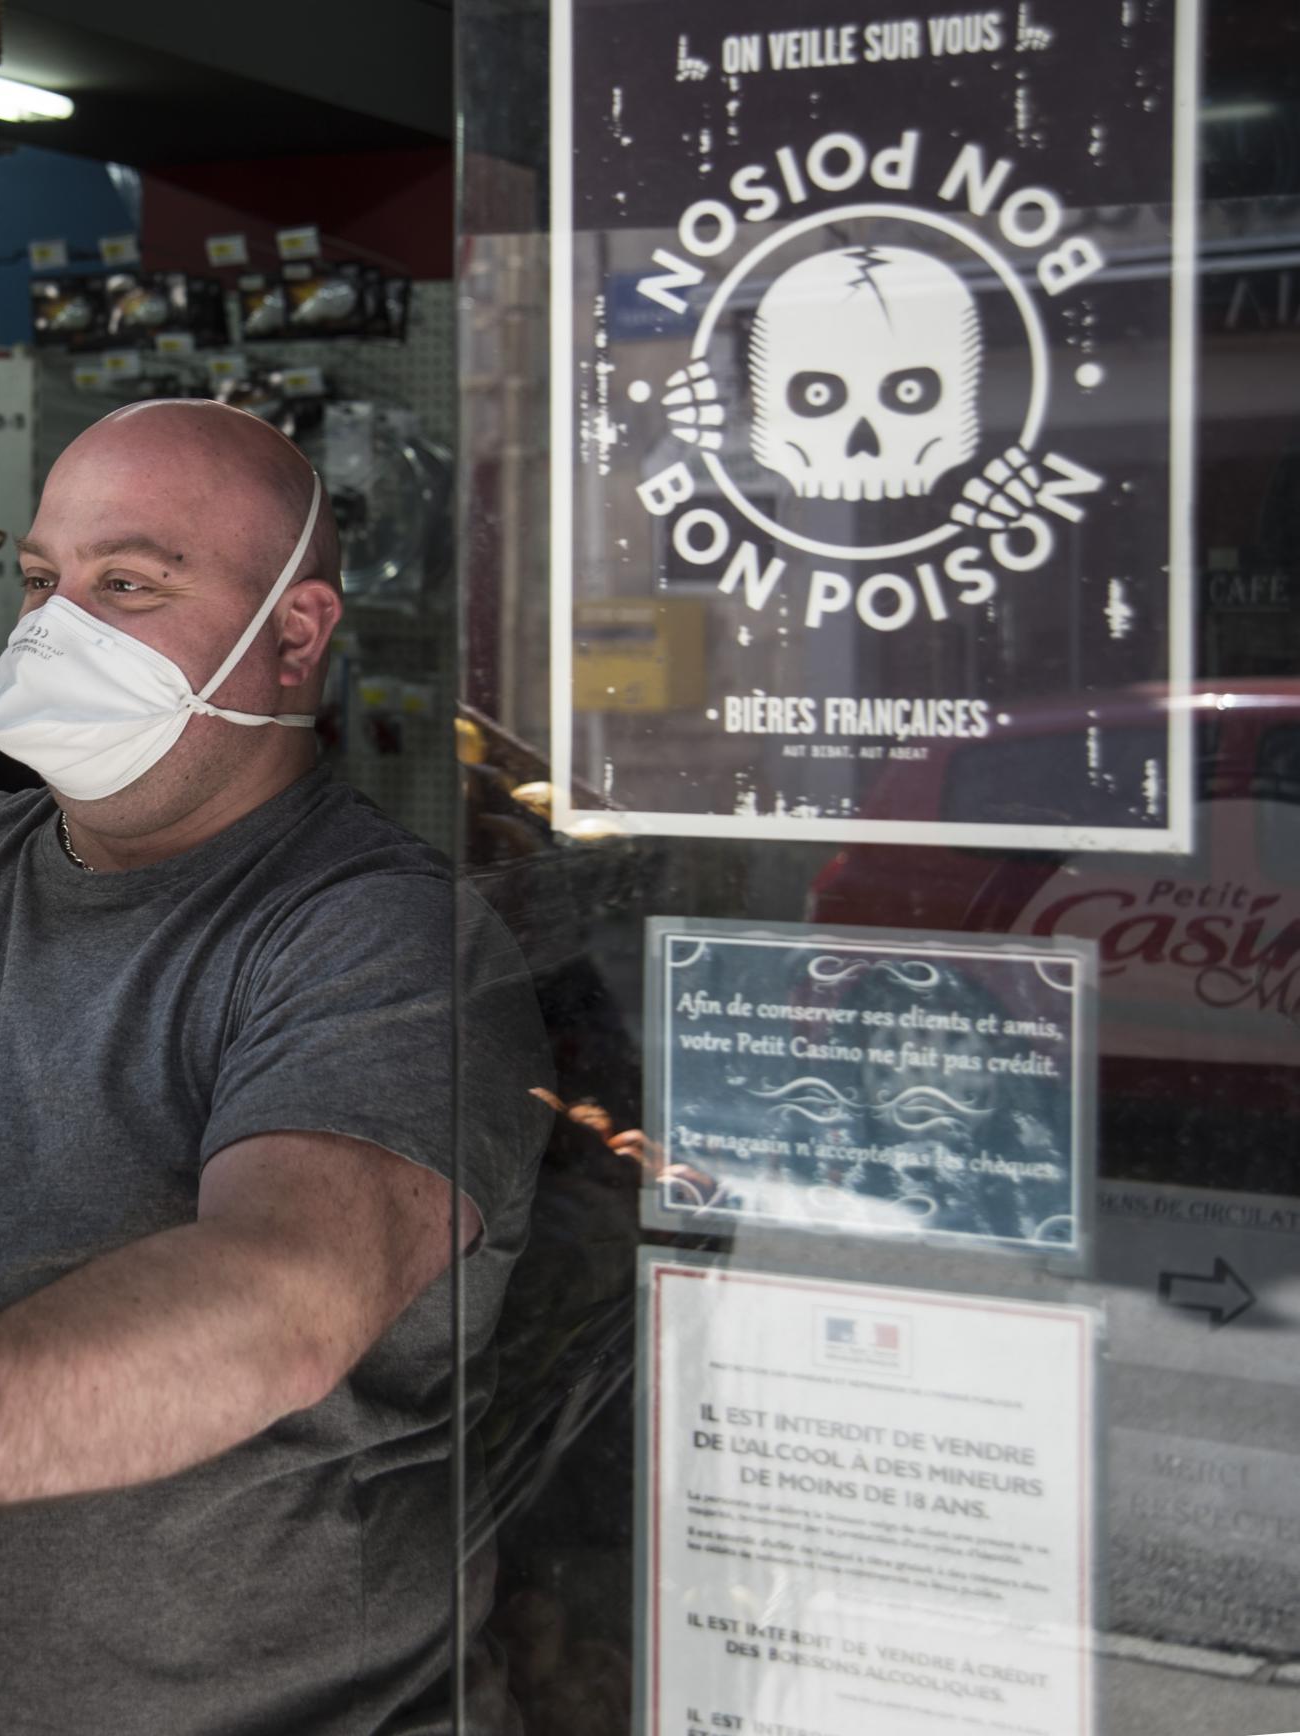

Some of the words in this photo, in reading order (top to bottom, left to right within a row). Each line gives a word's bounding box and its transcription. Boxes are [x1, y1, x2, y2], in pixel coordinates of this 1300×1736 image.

[721, 34, 760, 74] ON
[769, 26, 857, 70] VEILLE
[864, 20, 919, 63] SUR
[929, 12, 1001, 56] VOUS
[636, 130, 919, 313] POISON
[938, 143, 1105, 297] BON
[636, 462, 787, 610] BON
[805, 452, 1103, 631] POISON
[725, 688, 816, 733] BIÈRES
[825, 698, 989, 741] FRANÇAISES
[1149, 880, 1248, 909] Petit
[677, 991, 721, 1022] Afin
[726, 993, 753, 1017] de
[757, 1001, 857, 1025] conserver
[861, 1010, 894, 1027] ses
[899, 1007, 970, 1032] clients
[976, 1015, 998, 1034] et
[1002, 1015, 1063, 1040] amis,
[680, 1034, 732, 1053] votre
[737, 1032, 785, 1057] Petit
[790, 1036, 862, 1062] Casino
[868, 1046, 894, 1065] ne
[895, 1041, 938, 1071] fait
[943, 1050, 981, 1074] pas
[987, 1048, 1059, 1077] crédit.
[707, 1132, 790, 1159] magasin
[892, 1148, 930, 1173] pas
[700, 1403, 719, 1423] IL
[726, 1407, 767, 1430] EST
[775, 1412, 886, 1446] INTERDIT
[893, 1430, 926, 1451] DE
[931, 1434, 1035, 1467] VENDRE
[693, 1431, 725, 1451] DE
[730, 1434, 843, 1469] L'ALCOOL
[850, 1449, 871, 1473] À
[875, 1459, 922, 1480] DES
[927, 1464, 1044, 1498] MINEURS
[740, 1465, 772, 1487] DE
[777, 1471, 858, 1500] MOINS
[863, 1484, 897, 1506] DE
[904, 1490, 926, 1511] 18
[931, 1496, 990, 1520] ANS.
[687, 1612, 703, 1629] IL
[707, 1615, 740, 1635] EST
[745, 1621, 832, 1650] INTERDIT
[842, 1640, 868, 1657] DE
[876, 1643, 955, 1673] VENDRE
[978, 1660, 1049, 1690] CRÉDIT
[726, 1640, 760, 1659] DES
[768, 1645, 861, 1679] BOISSONS
[687, 1707, 703, 1724] IL
[711, 1712, 743, 1731] EST
